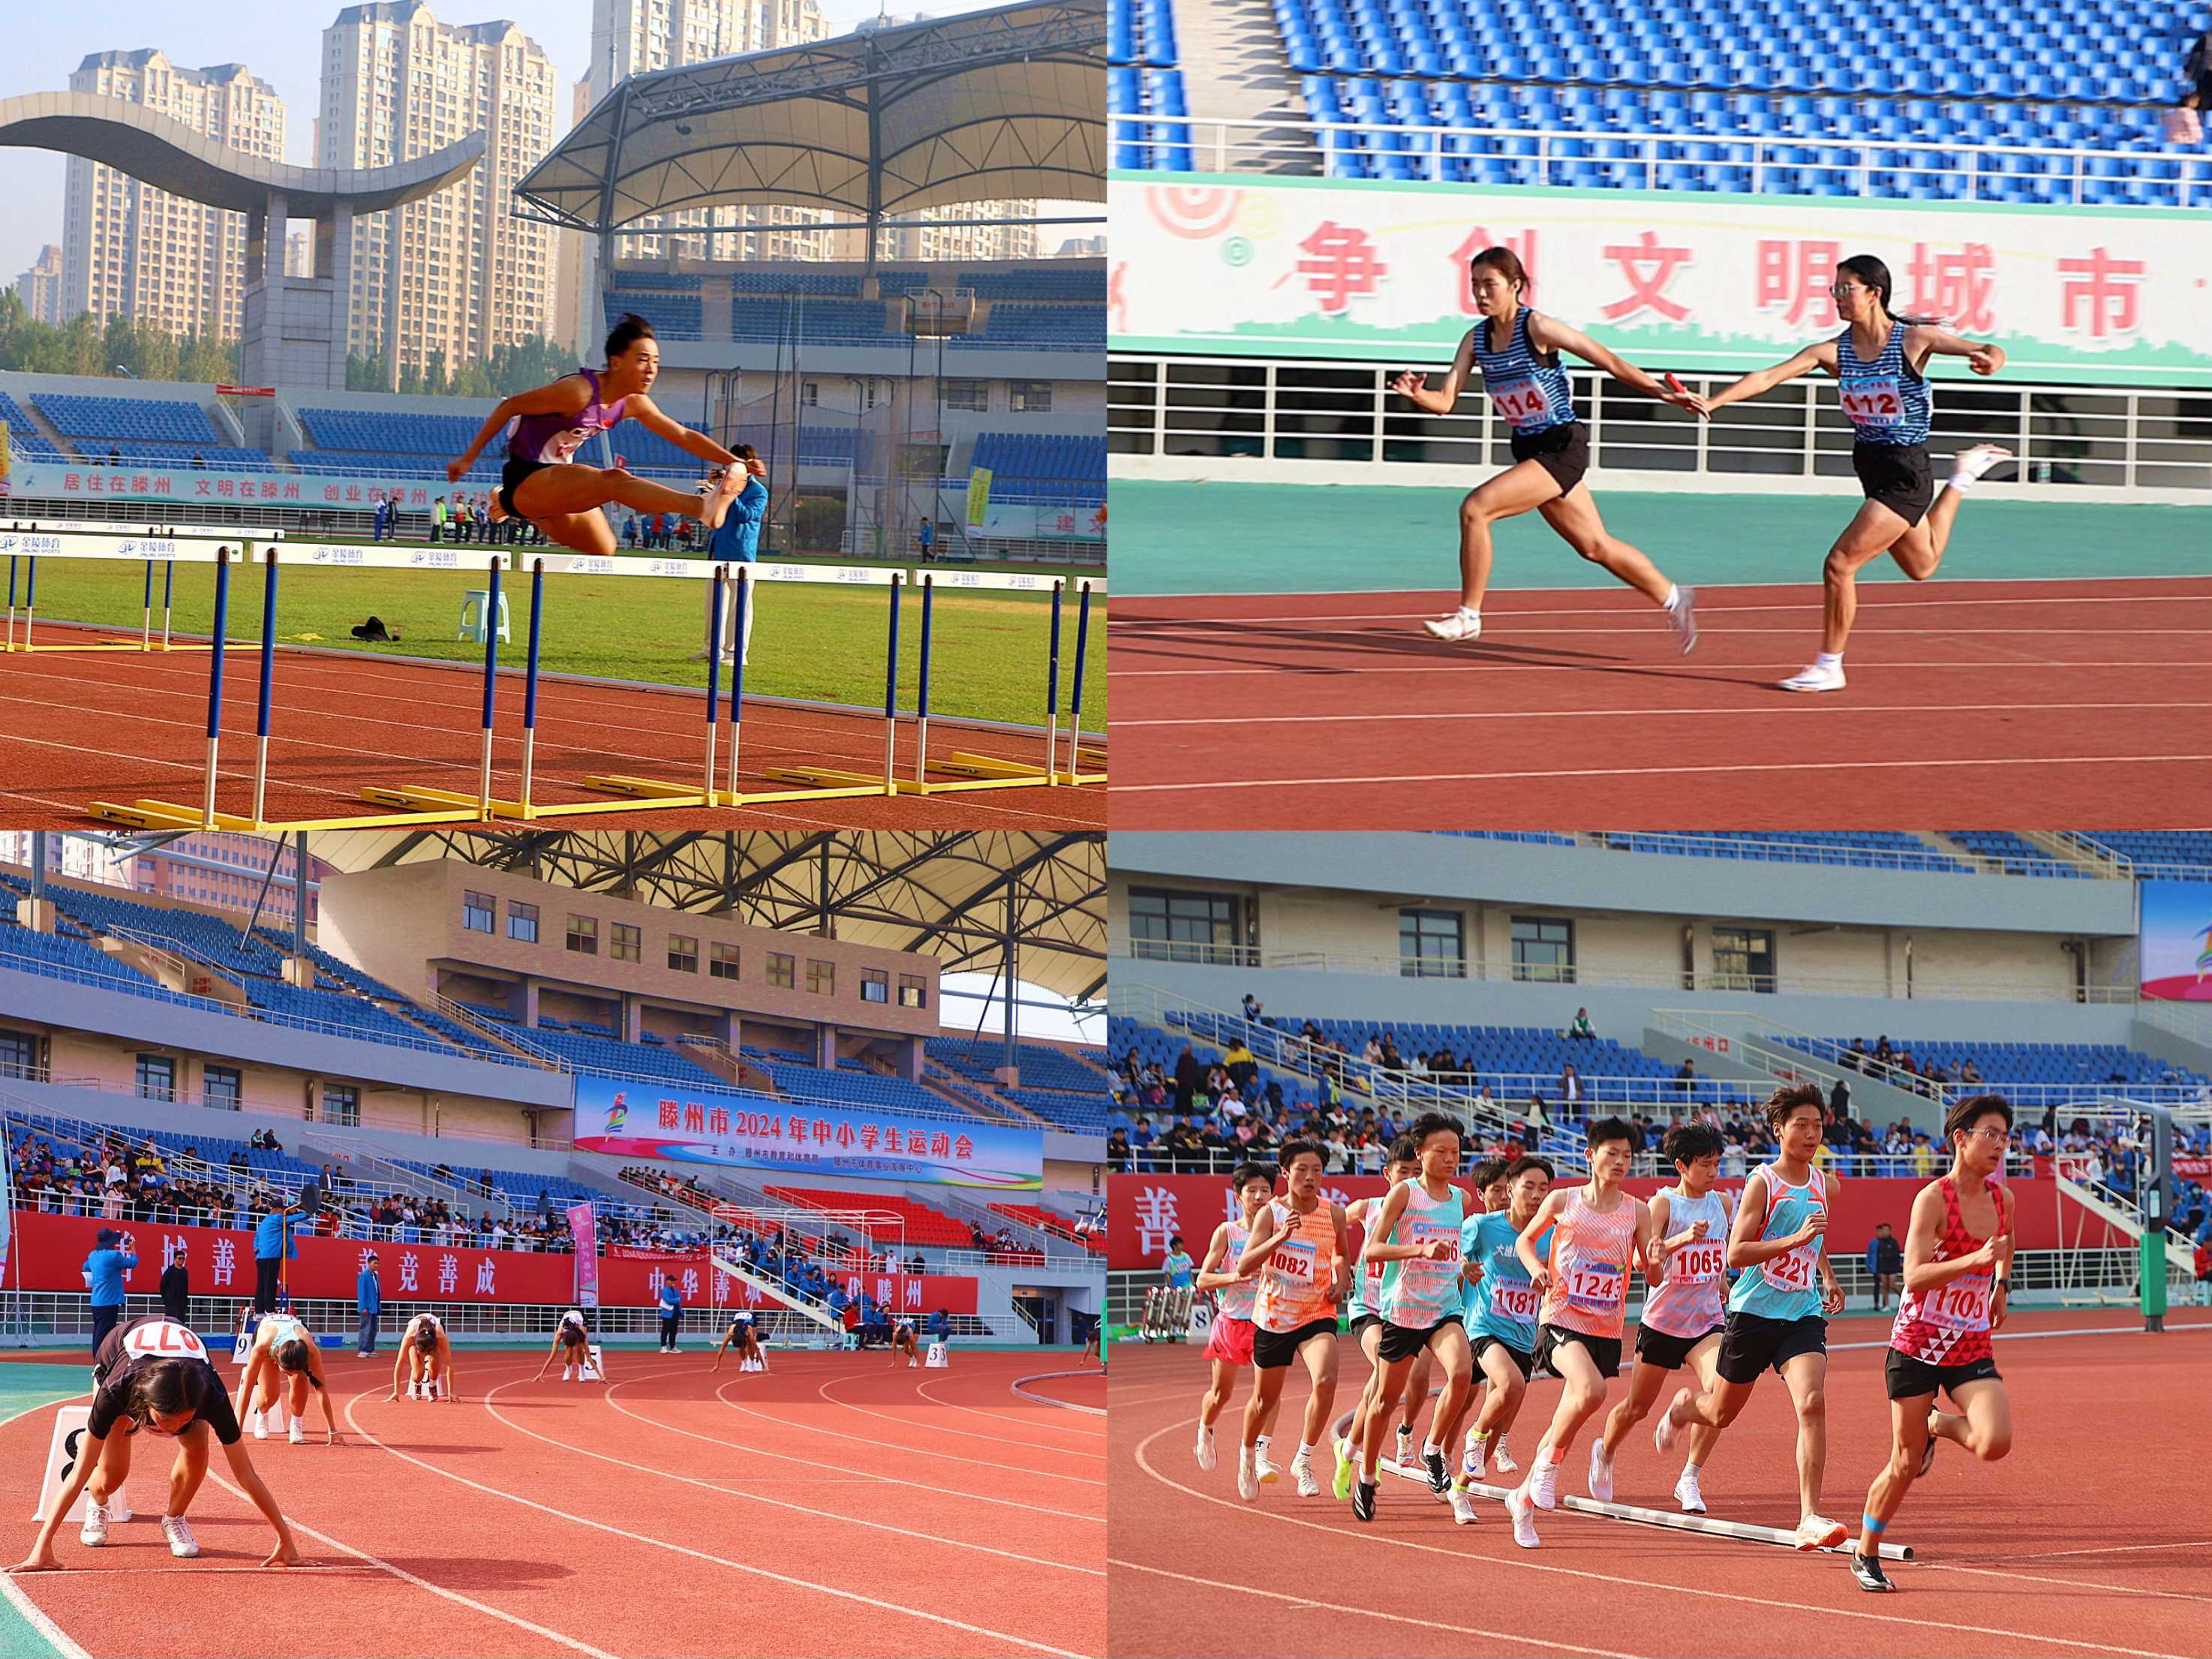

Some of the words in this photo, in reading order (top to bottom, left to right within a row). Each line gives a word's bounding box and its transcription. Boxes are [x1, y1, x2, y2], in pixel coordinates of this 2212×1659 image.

[1297, 220, 2145, 338] 争创文明城市
[1496, 390, 1543, 416] 114
[1843, 393, 1898, 414] 112
[63, 473, 172, 494] 居住在滕州
[194, 478, 300, 500] 文明在滕州
[1269, 1249, 1309, 1277] 1082
[1677, 1249, 1724, 1276] 1065
[1495, 1288, 1537, 1316] 1181
[1195, 1312, 1207, 1329] 8
[238, 1337, 248, 1355] 9
[930, 1347, 939, 1360] 3
[940, 1348, 947, 1361] 3
